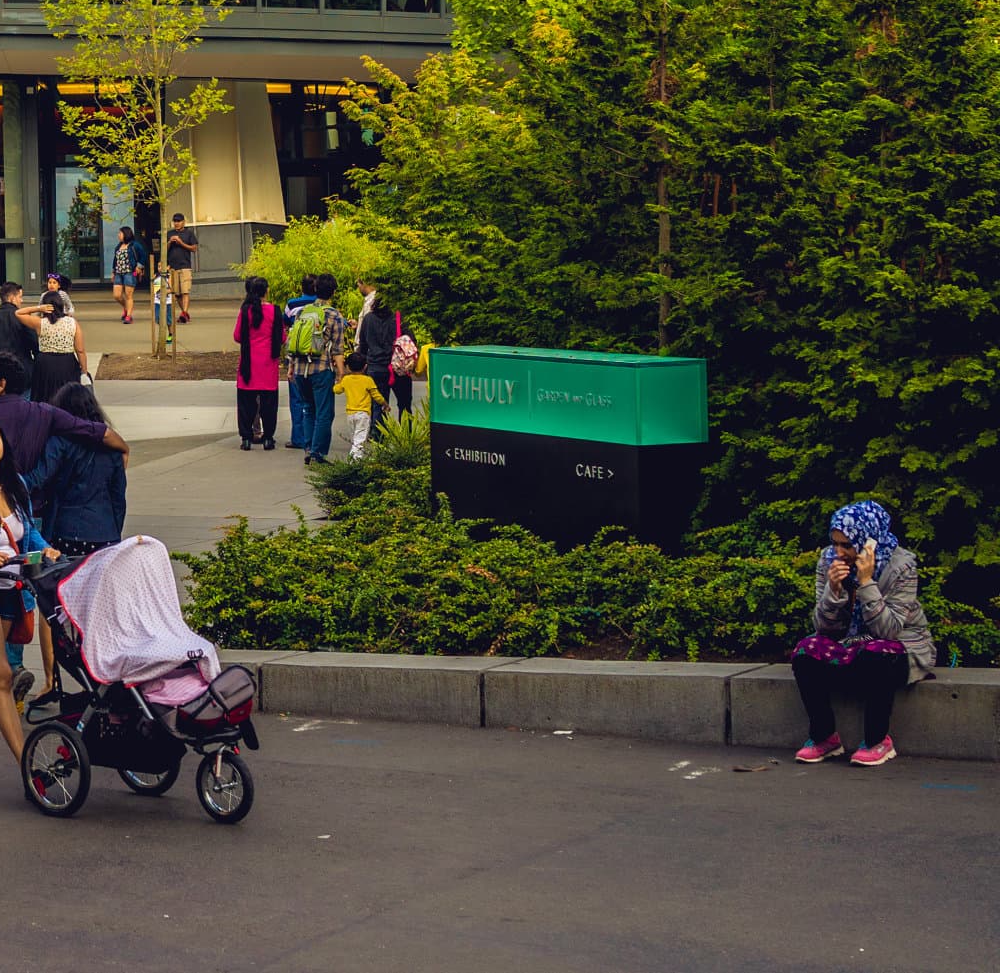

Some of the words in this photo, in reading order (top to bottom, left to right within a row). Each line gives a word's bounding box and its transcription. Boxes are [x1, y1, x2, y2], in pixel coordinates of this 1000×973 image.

[441, 374, 516, 404] CHIHULY
[454, 447, 506, 466] EXHIBITION
[575, 463, 604, 479] CAFE
